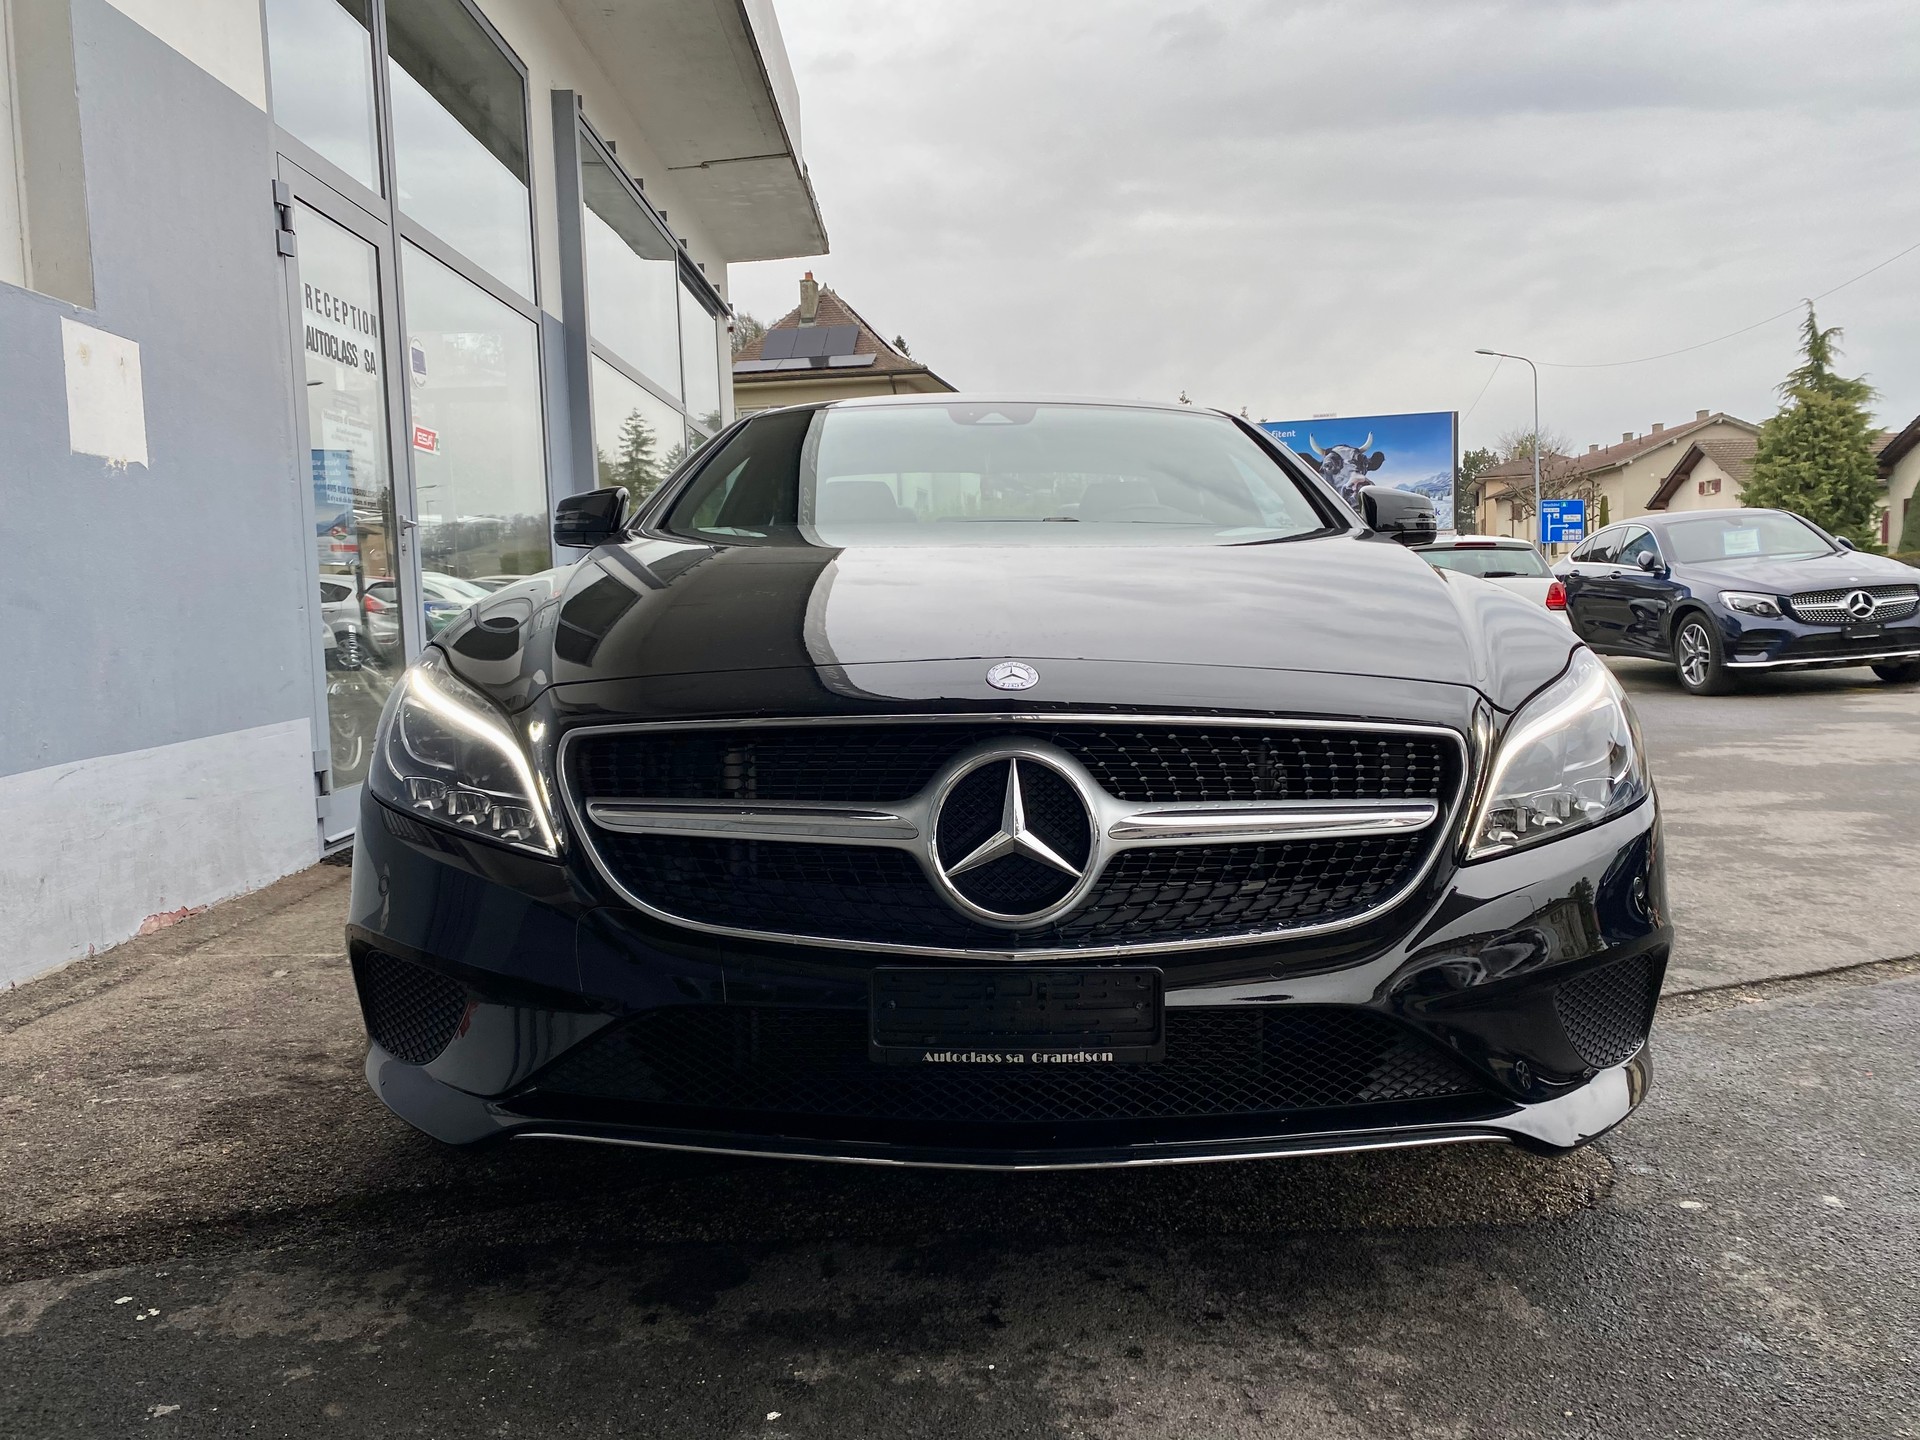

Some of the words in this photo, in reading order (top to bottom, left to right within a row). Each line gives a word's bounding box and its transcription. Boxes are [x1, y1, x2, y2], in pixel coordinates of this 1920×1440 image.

[304, 283, 377, 338] RECEPTION
[306, 325, 358, 368] AUTOCLASS
[364, 349, 377, 375] SA
[922, 1051, 1002, 1063] Autoclass
[1005, 1053, 1024, 1063] sa
[1031, 1050, 1113, 1063] Grandson
